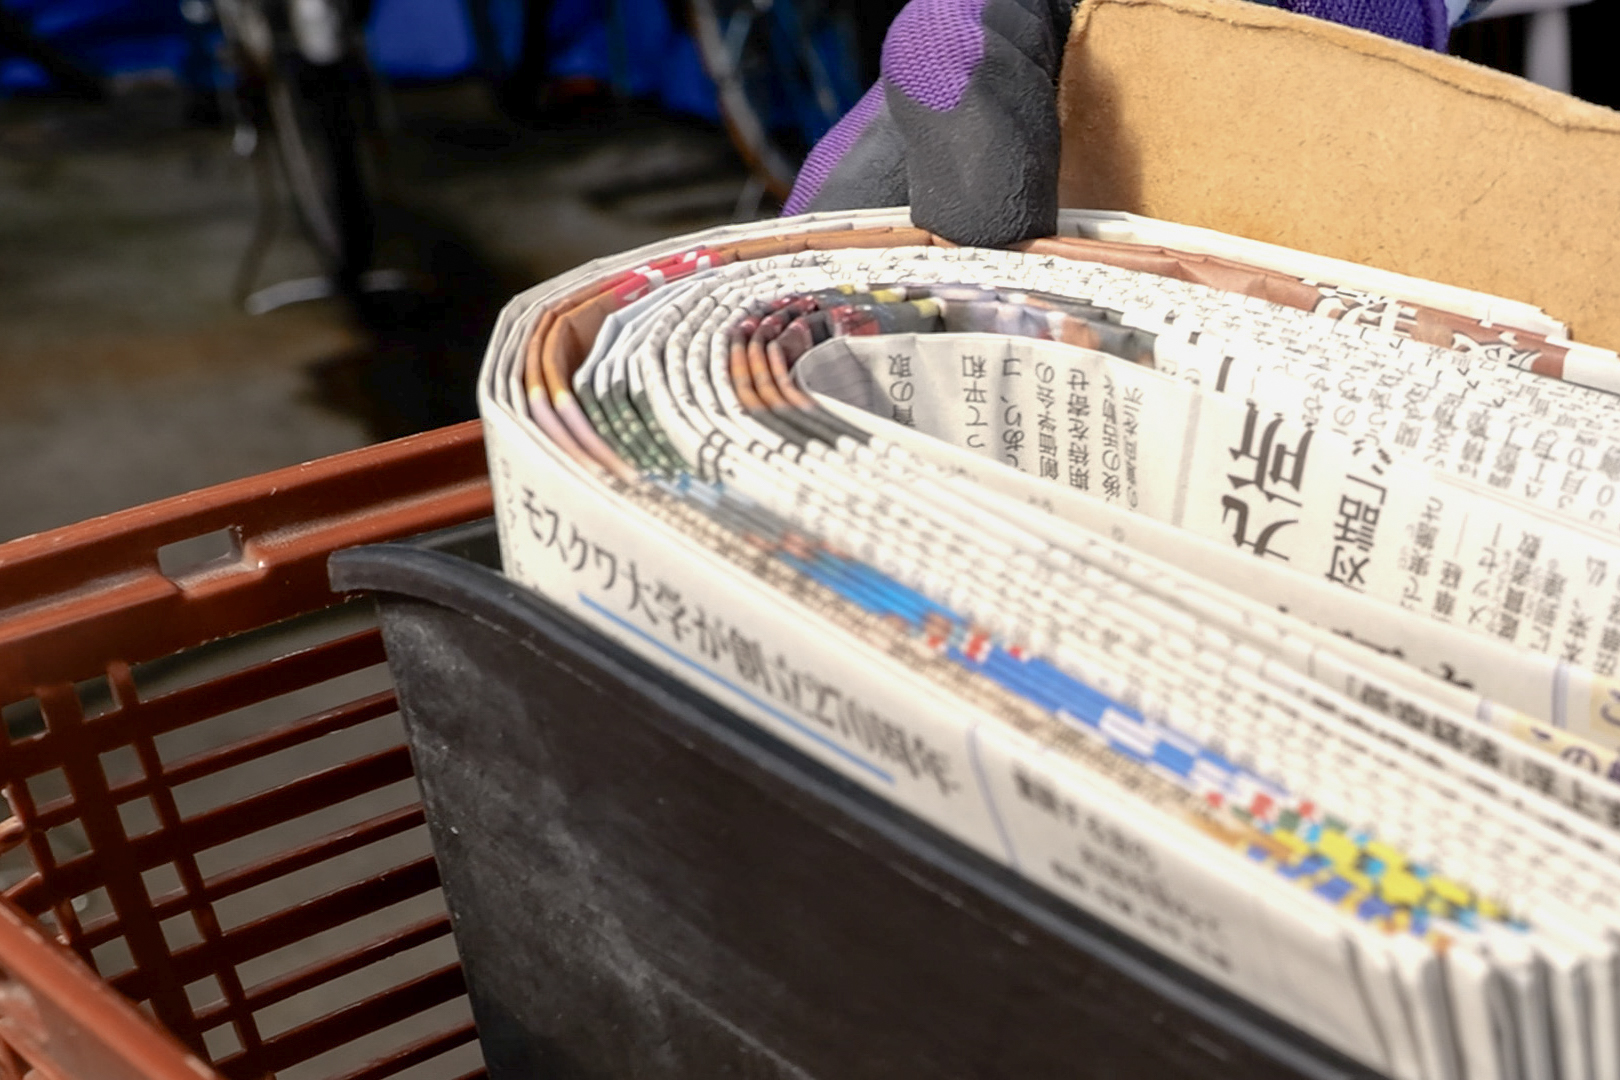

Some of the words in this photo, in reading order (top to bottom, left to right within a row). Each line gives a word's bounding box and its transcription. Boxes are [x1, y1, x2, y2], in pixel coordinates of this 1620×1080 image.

[961, 354, 987, 449] って平和
[1034, 361, 1060, 480] 創価学会の
[1067, 368, 1090, 491] 期待を寄せ
